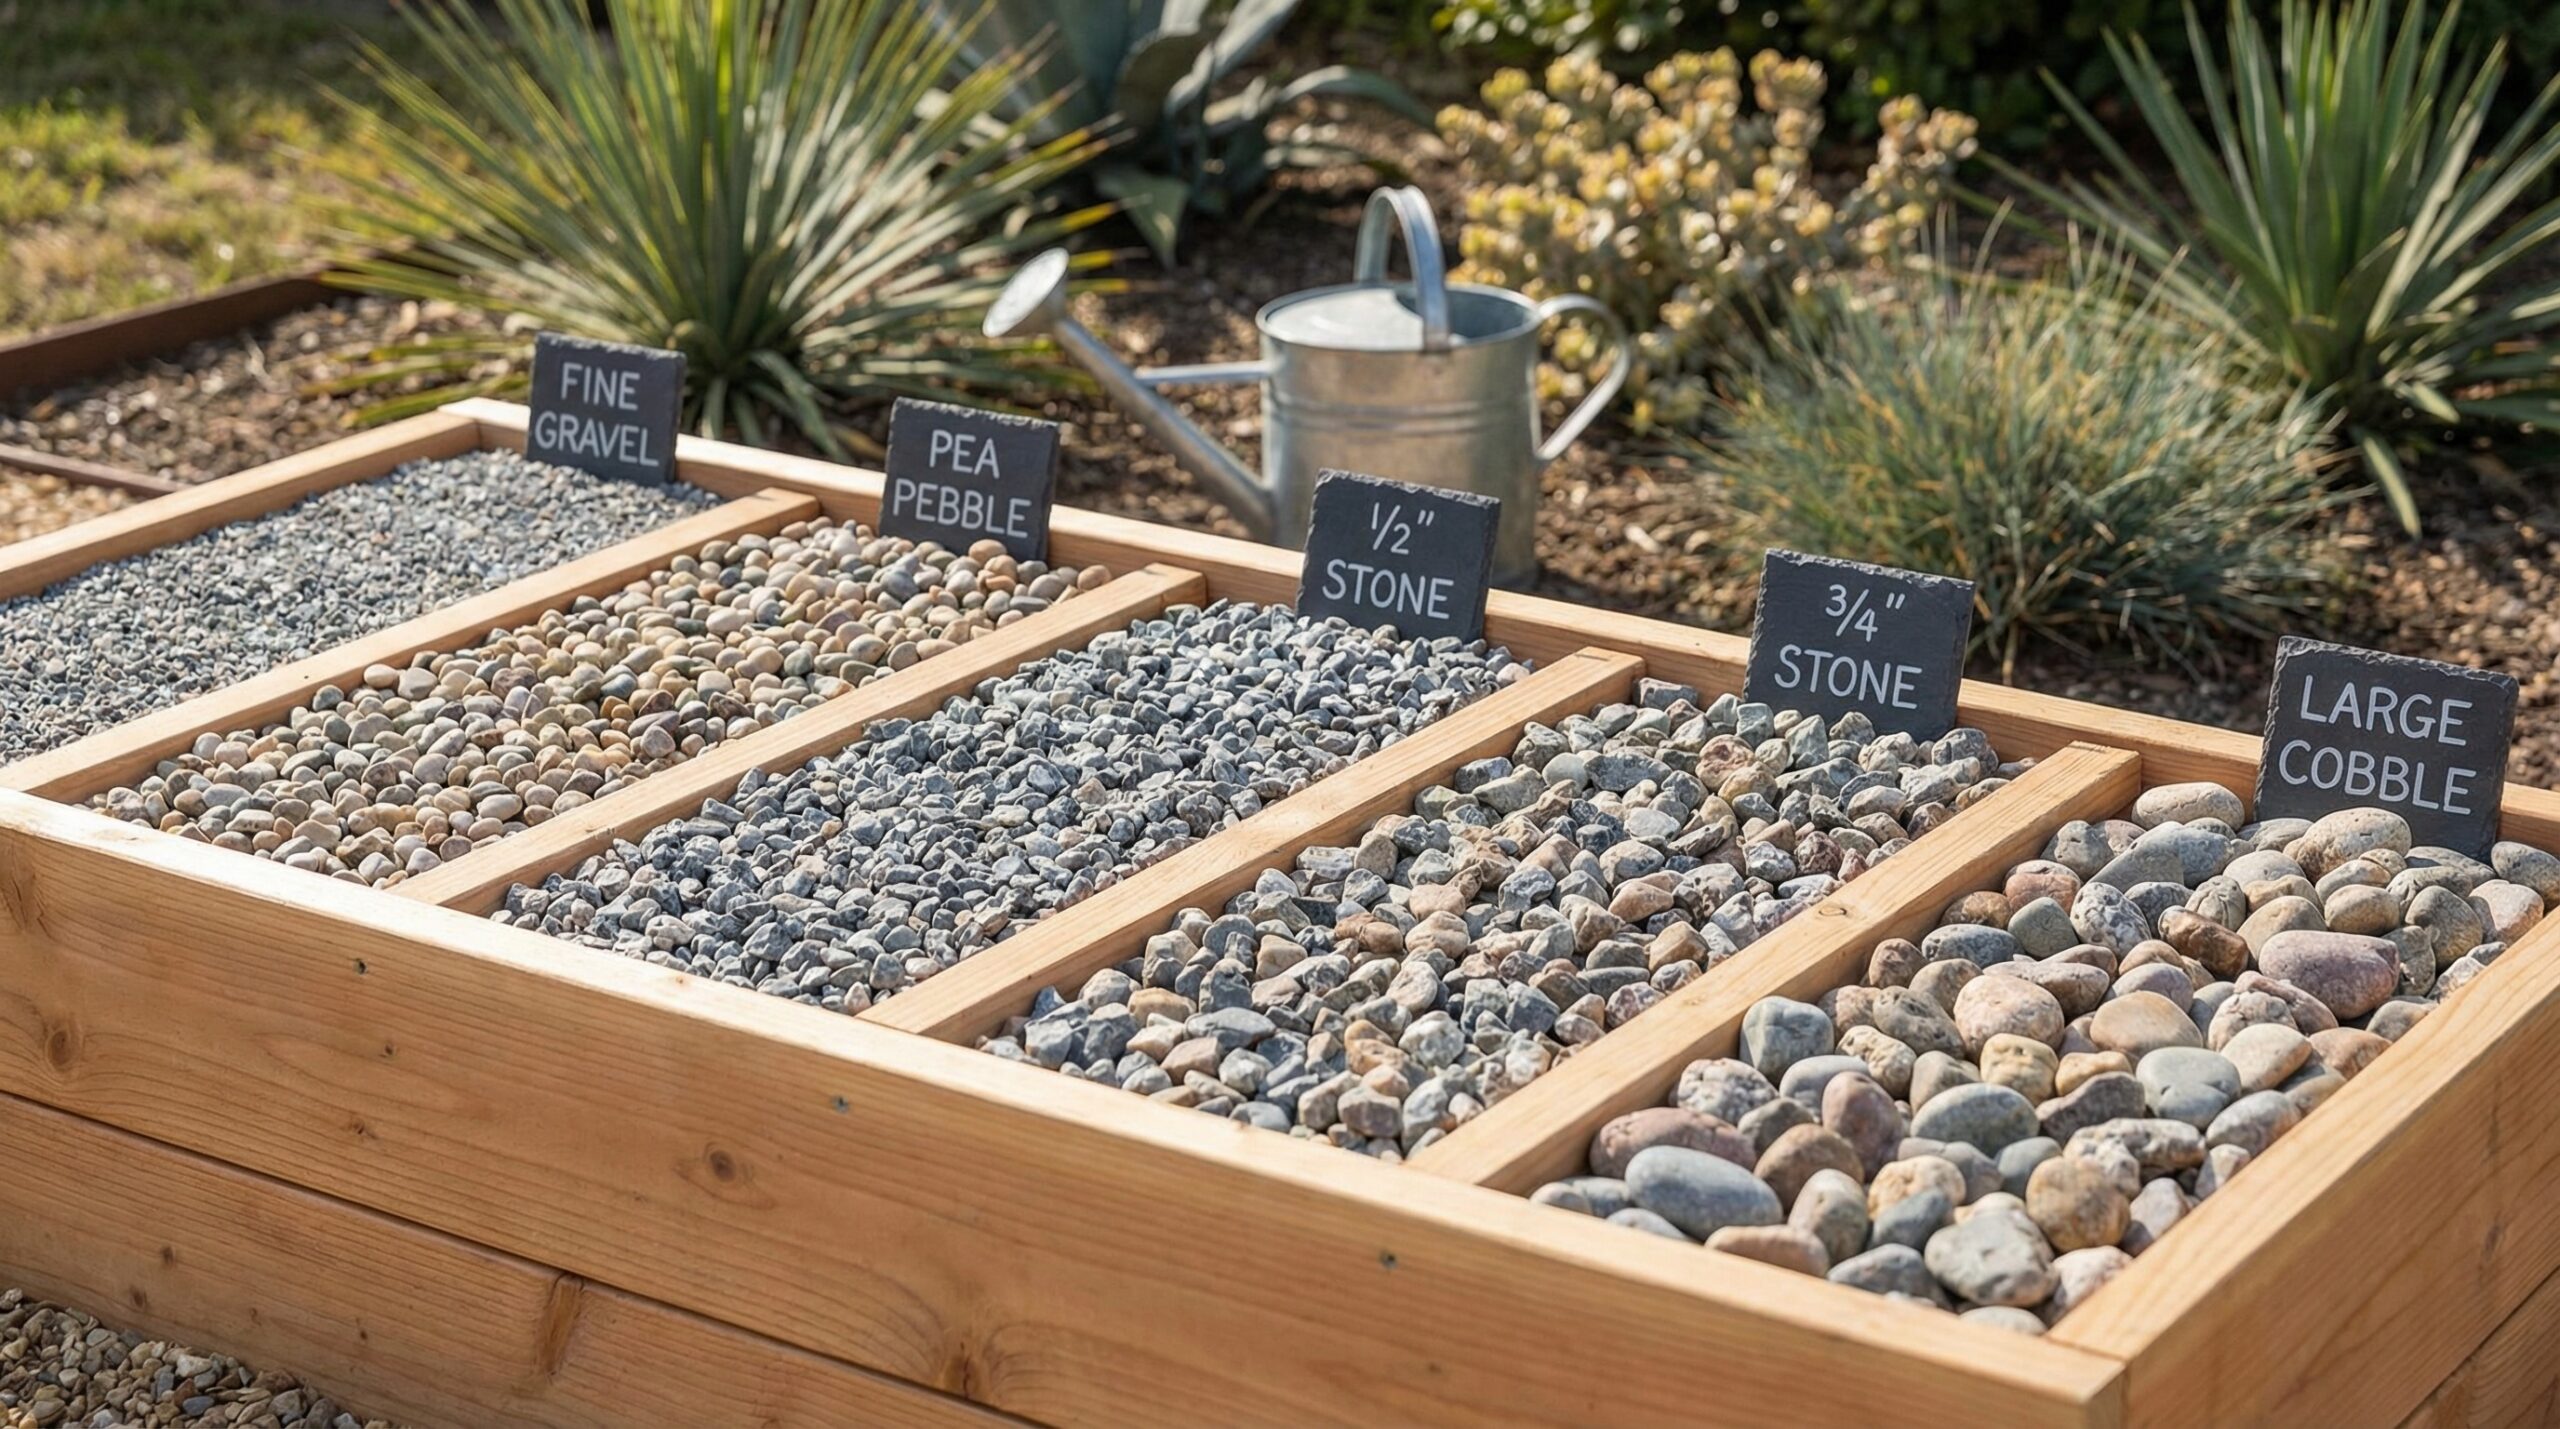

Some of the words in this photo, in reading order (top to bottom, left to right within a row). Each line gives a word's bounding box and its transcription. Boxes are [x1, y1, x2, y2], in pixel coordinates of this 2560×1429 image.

[562, 362, 640, 410] FINE
[535, 411, 659, 466] GRAVEL
[929, 429, 1000, 479] PEA
[893, 478, 1031, 538] PEBBLE
[1322, 558, 1454, 620] STONE
[1774, 644, 1923, 710] STONE
[2300, 674, 2473, 746] LARGE
[2278, 739, 2477, 815] COBBLE
